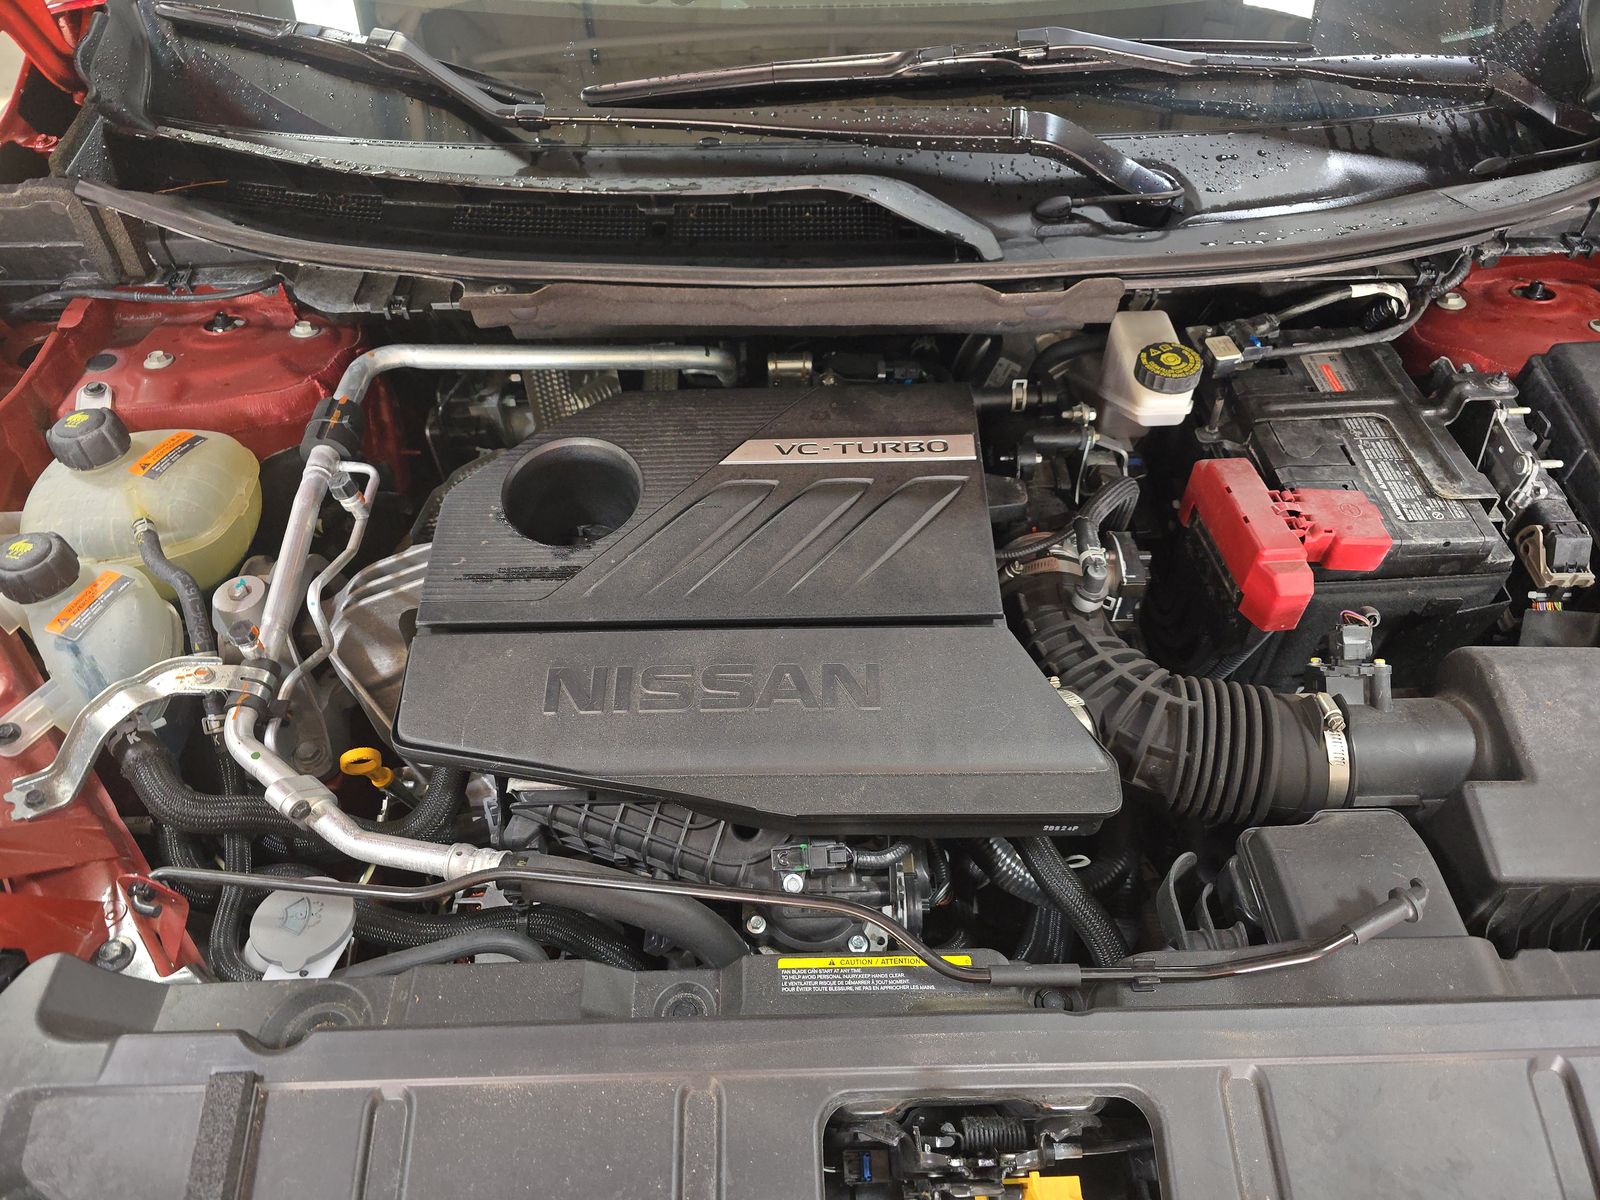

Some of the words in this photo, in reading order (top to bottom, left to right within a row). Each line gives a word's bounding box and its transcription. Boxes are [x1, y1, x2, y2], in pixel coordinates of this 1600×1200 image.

[774, 439, 949, 455] VC-TURBO
[543, 662, 881, 715] NISSAN
[839, 958, 873, 966] CAUTION
[880, 957, 921, 965] ATTENTION
